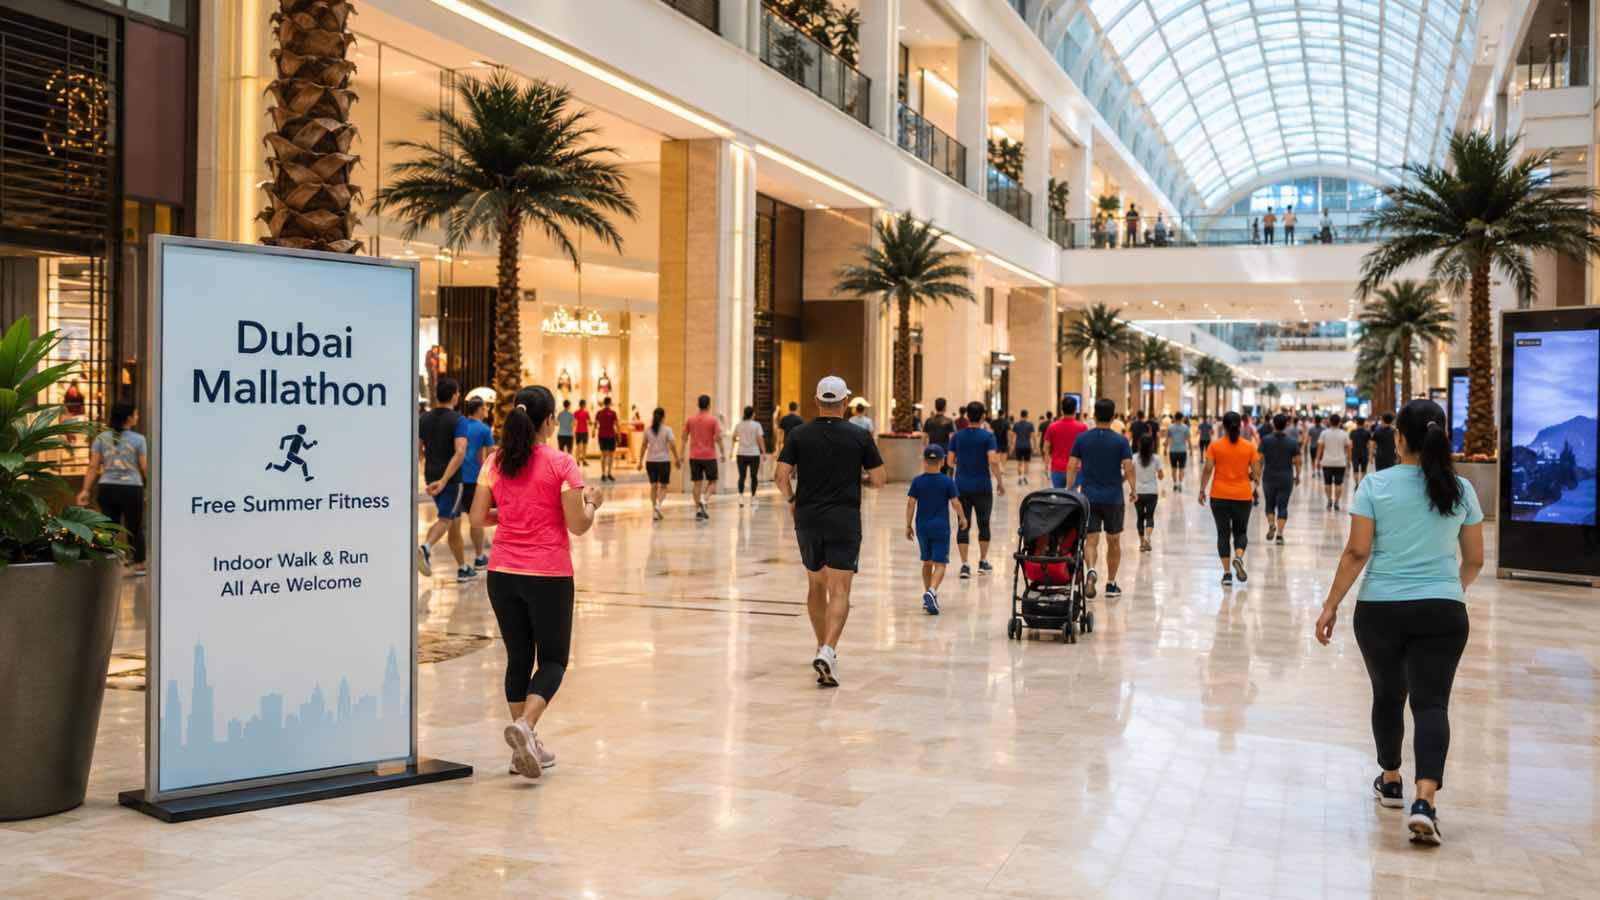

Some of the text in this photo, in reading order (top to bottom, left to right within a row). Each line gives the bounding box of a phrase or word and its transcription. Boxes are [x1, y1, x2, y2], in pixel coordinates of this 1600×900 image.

[237, 320, 353, 359] Dubai
[192, 369, 387, 407] Mallathon
[191, 492, 390, 515] Free Summer Fitness
[213, 550, 369, 572] Indoor Walk & Run
[220, 575, 362, 598] All Are Welcome
